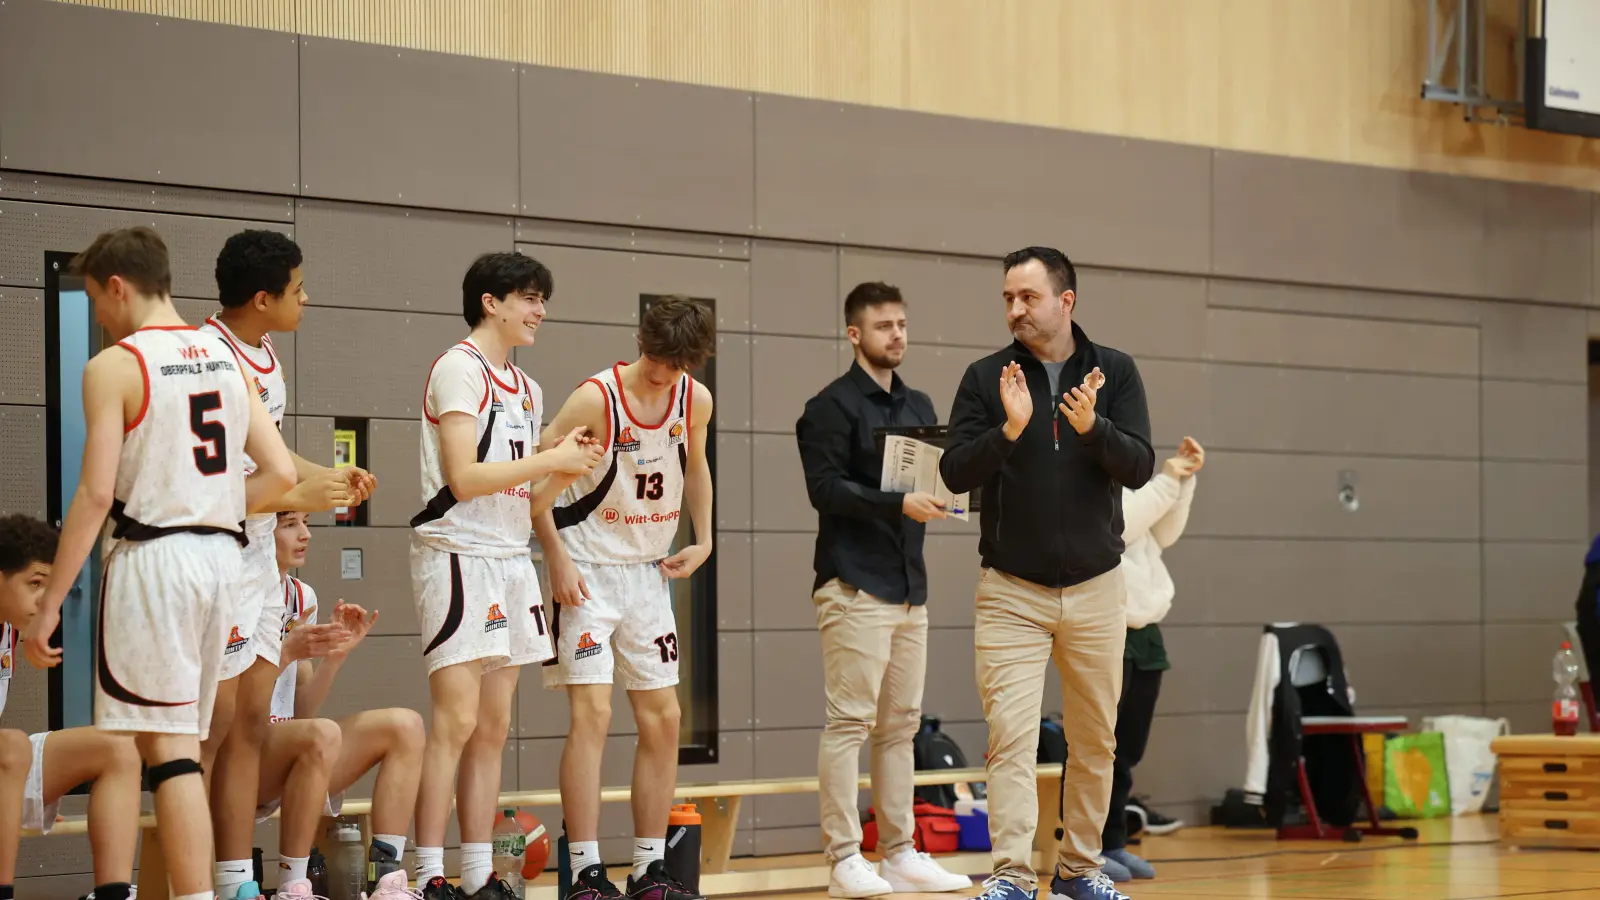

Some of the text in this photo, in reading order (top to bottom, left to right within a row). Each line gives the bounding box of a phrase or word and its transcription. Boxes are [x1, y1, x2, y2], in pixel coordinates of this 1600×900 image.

[188, 390, 227, 476] 5
[635, 472, 664, 500] 13
[624, 510, 680, 525] Witt-Grupp
[654, 632, 677, 662] 13
